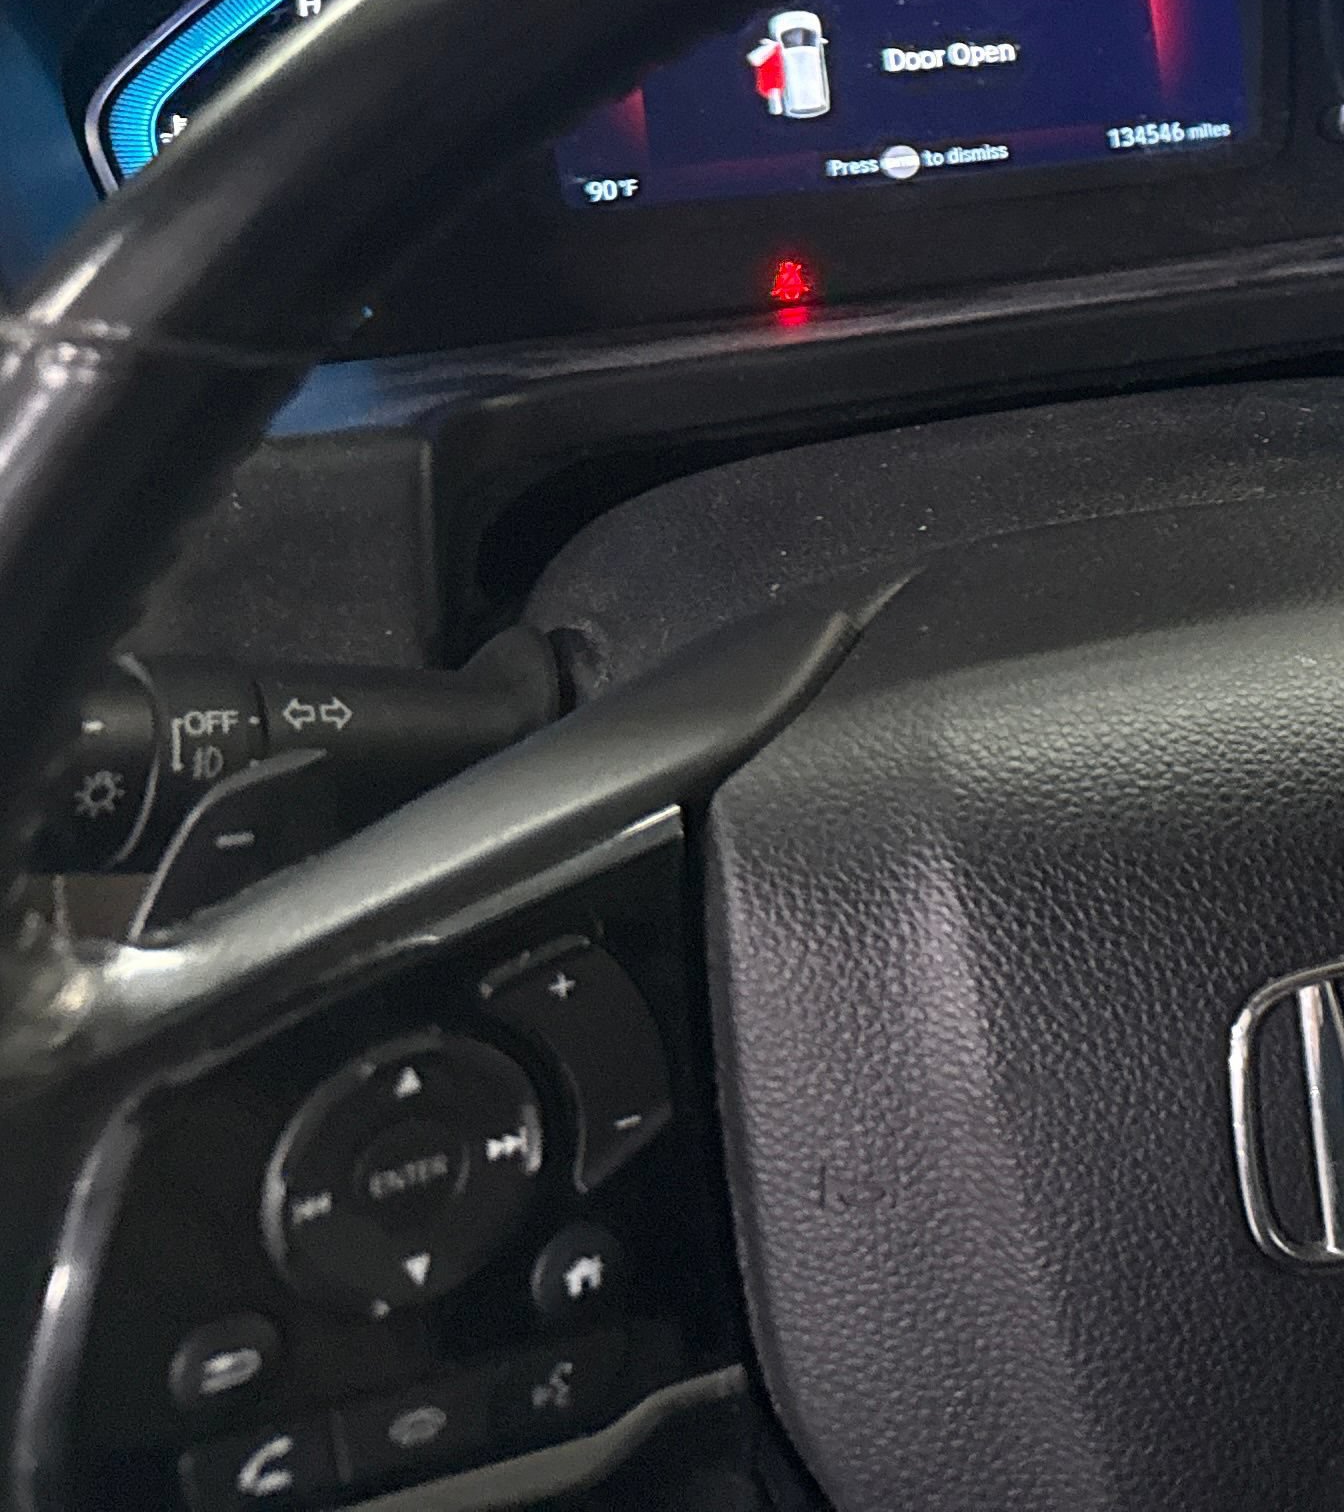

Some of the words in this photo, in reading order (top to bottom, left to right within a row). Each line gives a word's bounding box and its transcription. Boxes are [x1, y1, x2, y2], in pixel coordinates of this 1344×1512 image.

[882, 47, 945, 73] Door
[947, 42, 1017, 68] Open
[1107, 122, 1185, 150] 134546
[1186, 121, 1231, 140] miles
[826, 157, 879, 177] Press
[920, 149, 944, 167] to
[946, 143, 1009, 165] dismiss
[583, 178, 639, 203] 90°F
[184, 709, 239, 735] OFF
